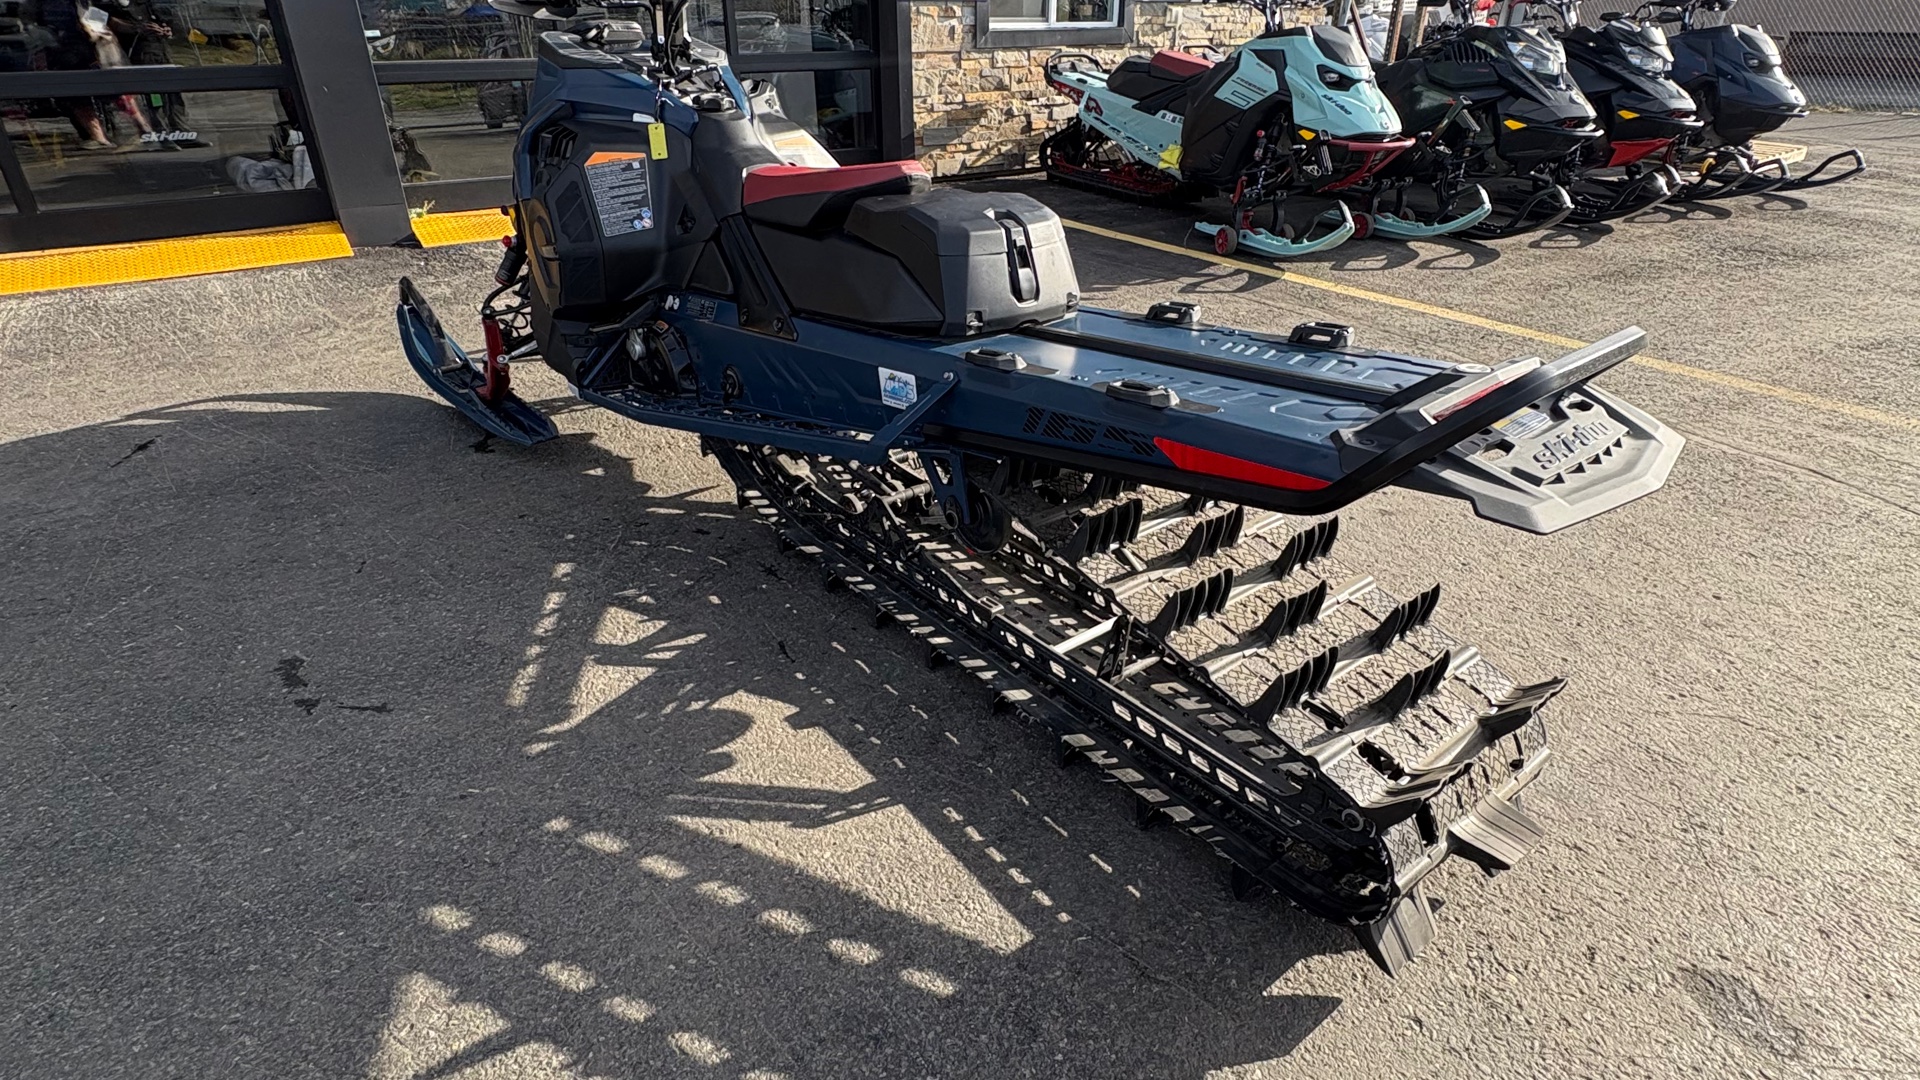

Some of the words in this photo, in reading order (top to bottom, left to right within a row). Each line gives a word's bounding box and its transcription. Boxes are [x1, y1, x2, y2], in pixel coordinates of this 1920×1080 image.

[140, 130, 198, 142] ski-doo
[1022, 406, 1157, 457] 165
[1532, 421, 1614, 470] ski-doo
